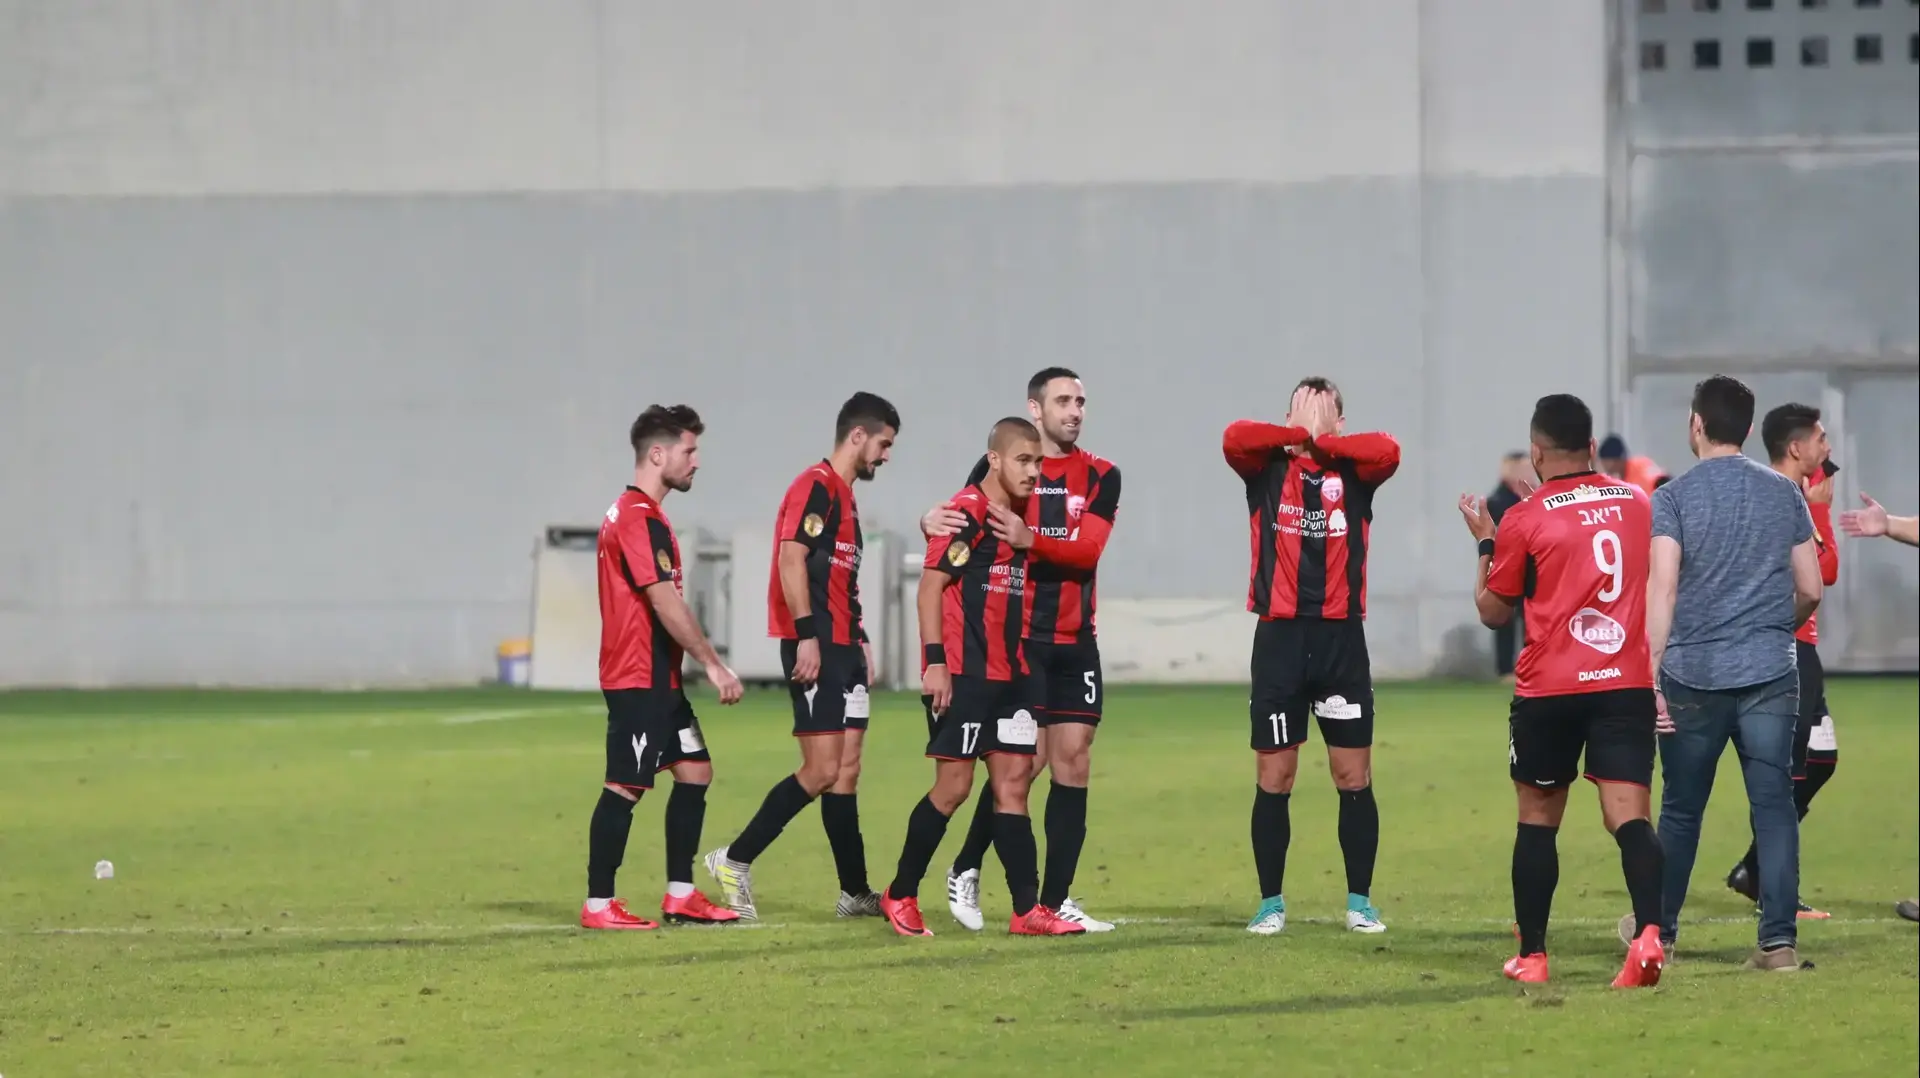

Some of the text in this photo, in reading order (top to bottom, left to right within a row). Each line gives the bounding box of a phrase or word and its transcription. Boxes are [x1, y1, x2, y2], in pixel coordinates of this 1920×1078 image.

[1034, 487, 1069, 495] DIADORA
[1544, 487, 1632, 509] מכבסת הנסיך
[1577, 505, 1623, 526] דיאב
[1592, 529, 1623, 603] 9
[1083, 670, 1096, 704] 5
[1578, 667, 1622, 682] DIADORA
[961, 722, 982, 754] 17
[1268, 712, 1288, 745] 11
